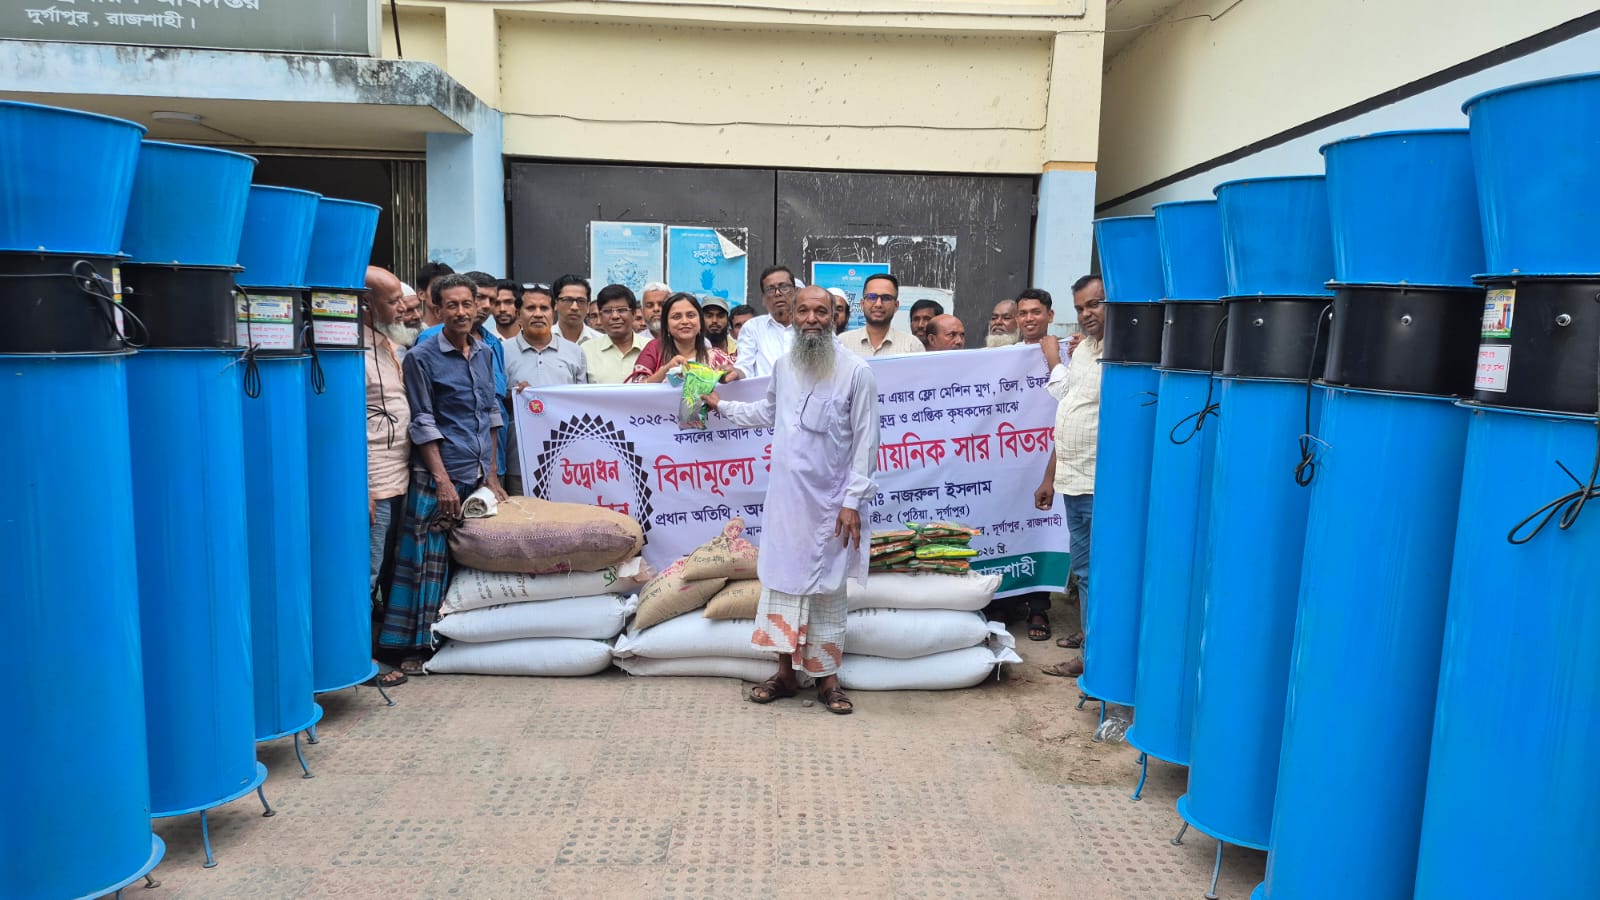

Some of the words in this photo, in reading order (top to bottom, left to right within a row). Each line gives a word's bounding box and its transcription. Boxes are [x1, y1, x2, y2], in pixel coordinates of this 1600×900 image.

[629, 413, 679, 428] ২০২৫-২
[940, 381, 971, 400] মেশিন
[673, 430, 713, 444] ফসলের
[717, 427, 749, 441] আবাদ
[899, 413, 908, 424] ও
[911, 406, 944, 424] প্রান্তিক
[947, 406, 992, 424] কৃষকদের
[994, 400, 1019, 414] মাঝে
[560, 457, 620, 490] উদ্বোধন
[653, 454, 756, 497] বিনামূল্যে
[951, 433, 992, 463] সার
[655, 509, 687, 526] প্রধান
[691, 504, 731, 523] অতিথি
[889, 485, 940, 505] নজরুল
[944, 480, 992, 499] ইসলাম
[1026, 513, 1063, 529] রাজশাহী
